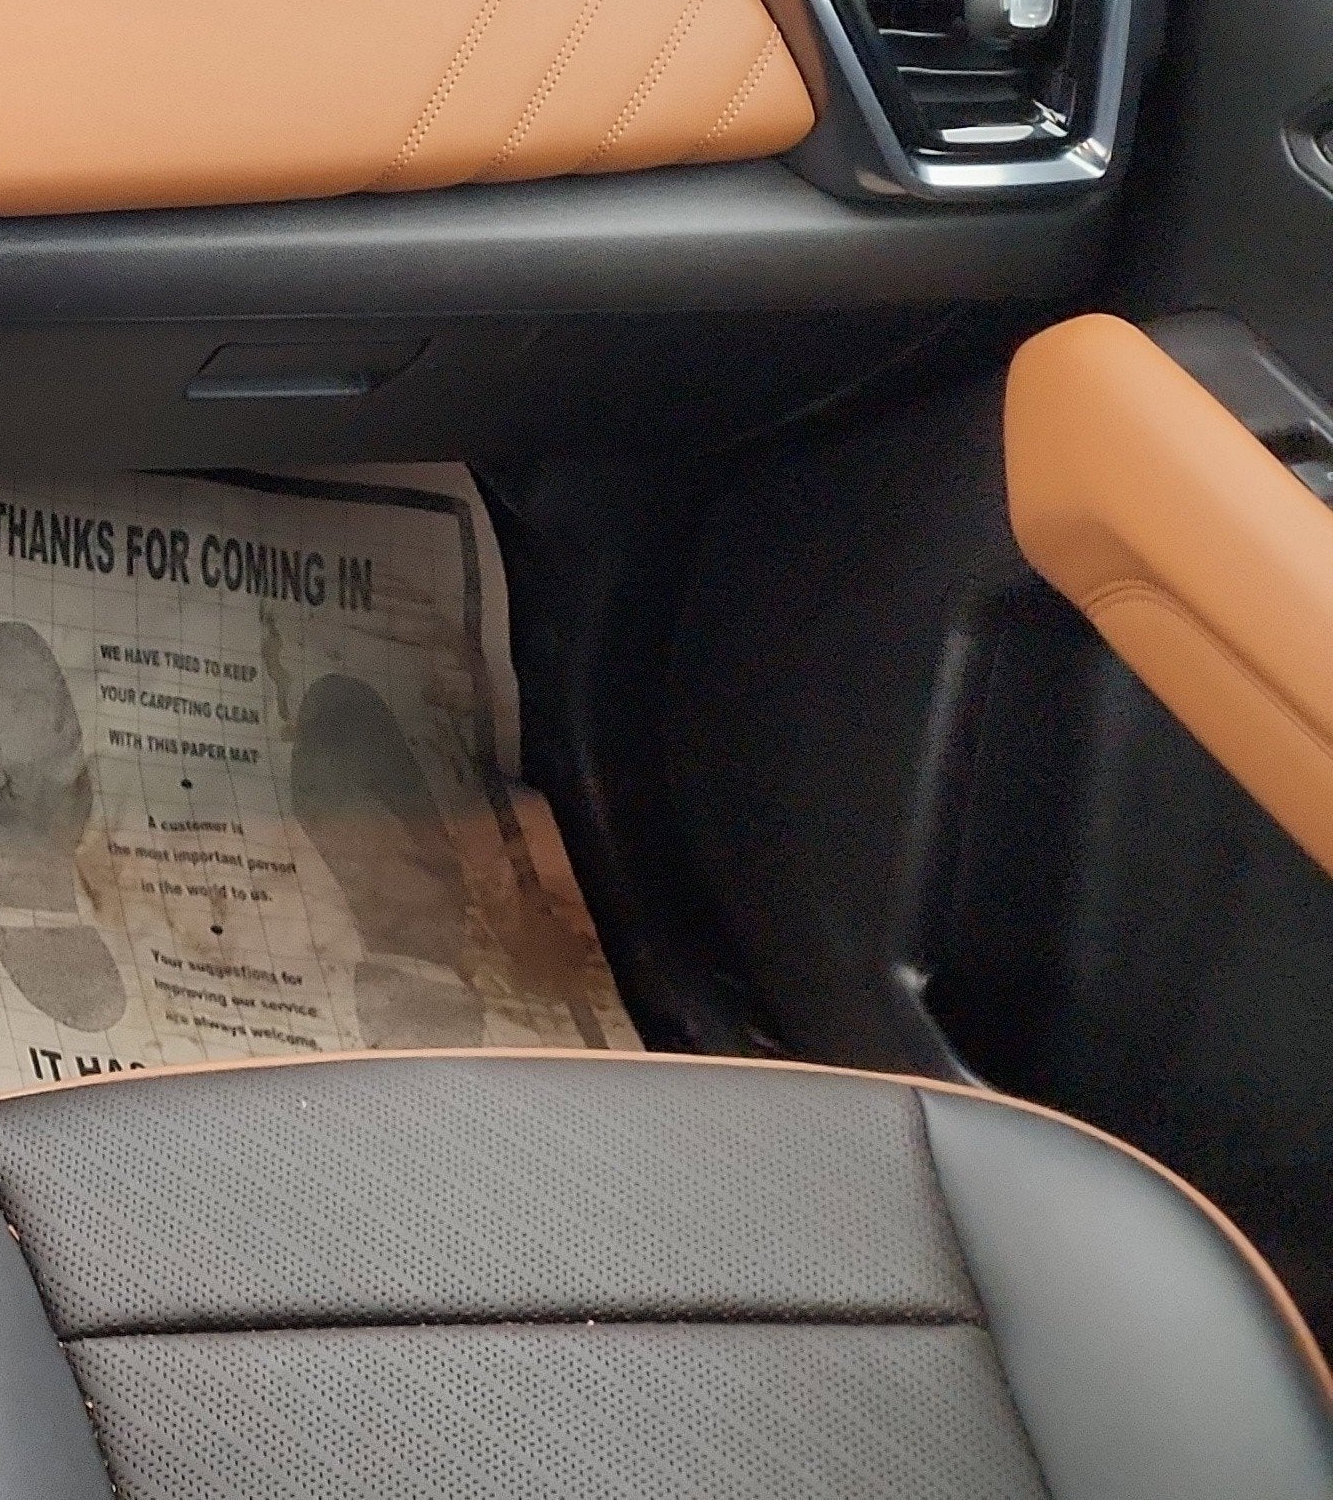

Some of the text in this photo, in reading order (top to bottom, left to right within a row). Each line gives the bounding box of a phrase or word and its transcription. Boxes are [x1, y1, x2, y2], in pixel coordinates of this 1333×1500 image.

[126, 527, 190, 584] FOR
[201, 534, 325, 606] COMING
[339, 558, 372, 610] IN
[101, 645, 257, 681] WE HAVE TRIED TO KEEP
[101, 686, 258, 724] YOUR CARPETING CLEAN
[109, 730, 258, 763] WITH THIS PAPER MAT
[148, 816, 242, 834] A customer is
[108, 844, 295, 874] the most important person
[141, 880, 272, 902] in the world to us.
[151, 950, 302, 985] Your suggestions for
[231, 996, 256, 1007] our
[261, 1000, 317, 1018] service
[194, 1015, 246, 1036] always
[29, 1047, 62, 1082] IT
